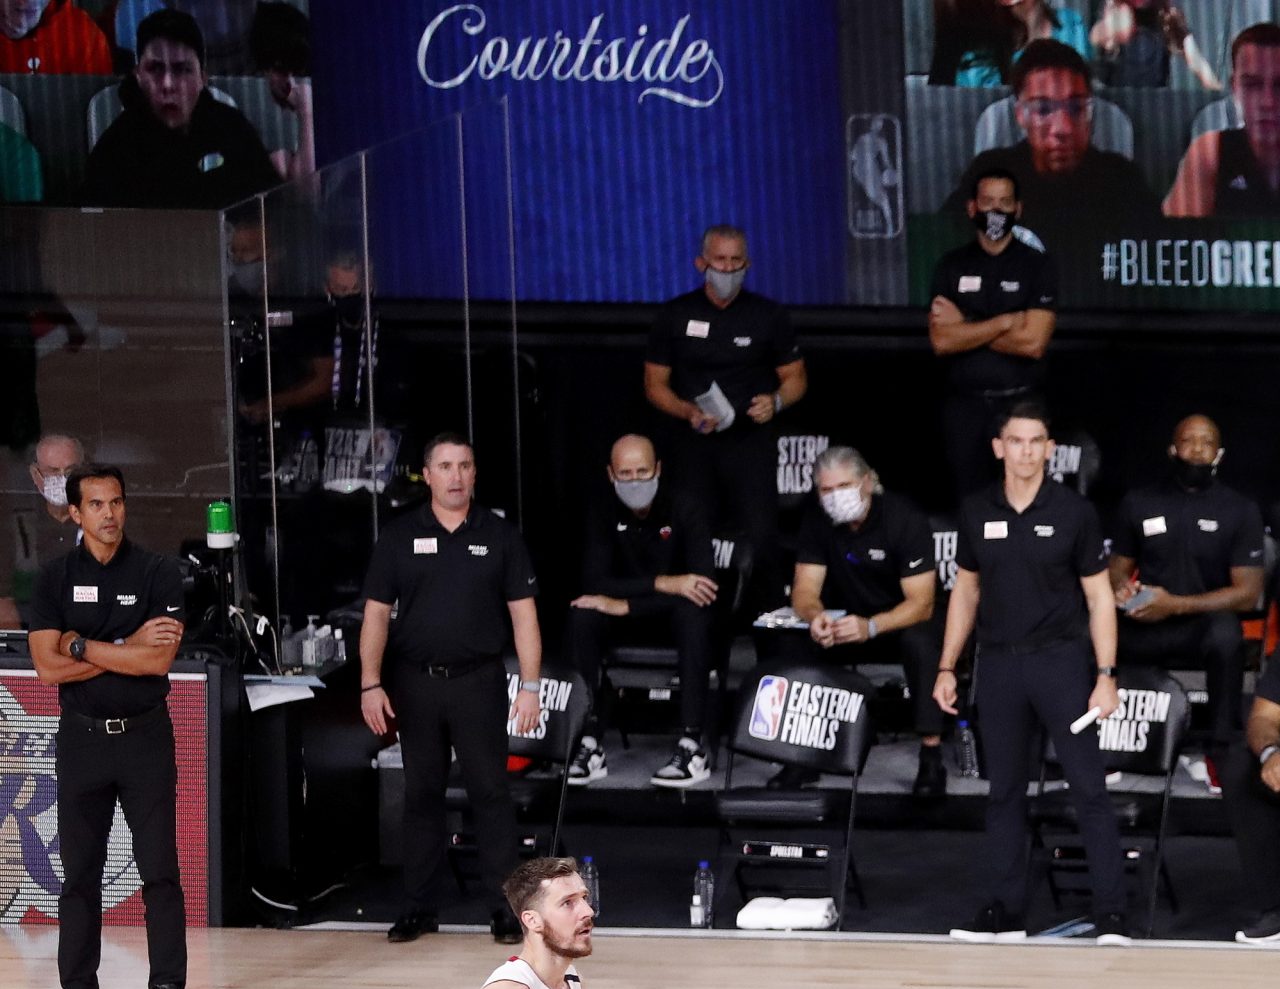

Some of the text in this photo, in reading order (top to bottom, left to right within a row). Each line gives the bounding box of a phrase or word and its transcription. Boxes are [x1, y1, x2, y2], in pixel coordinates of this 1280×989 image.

[417, 4, 724, 108] Courtside
[787, 680, 864, 723] EASTERN
[780, 711, 839, 750] FINALS
